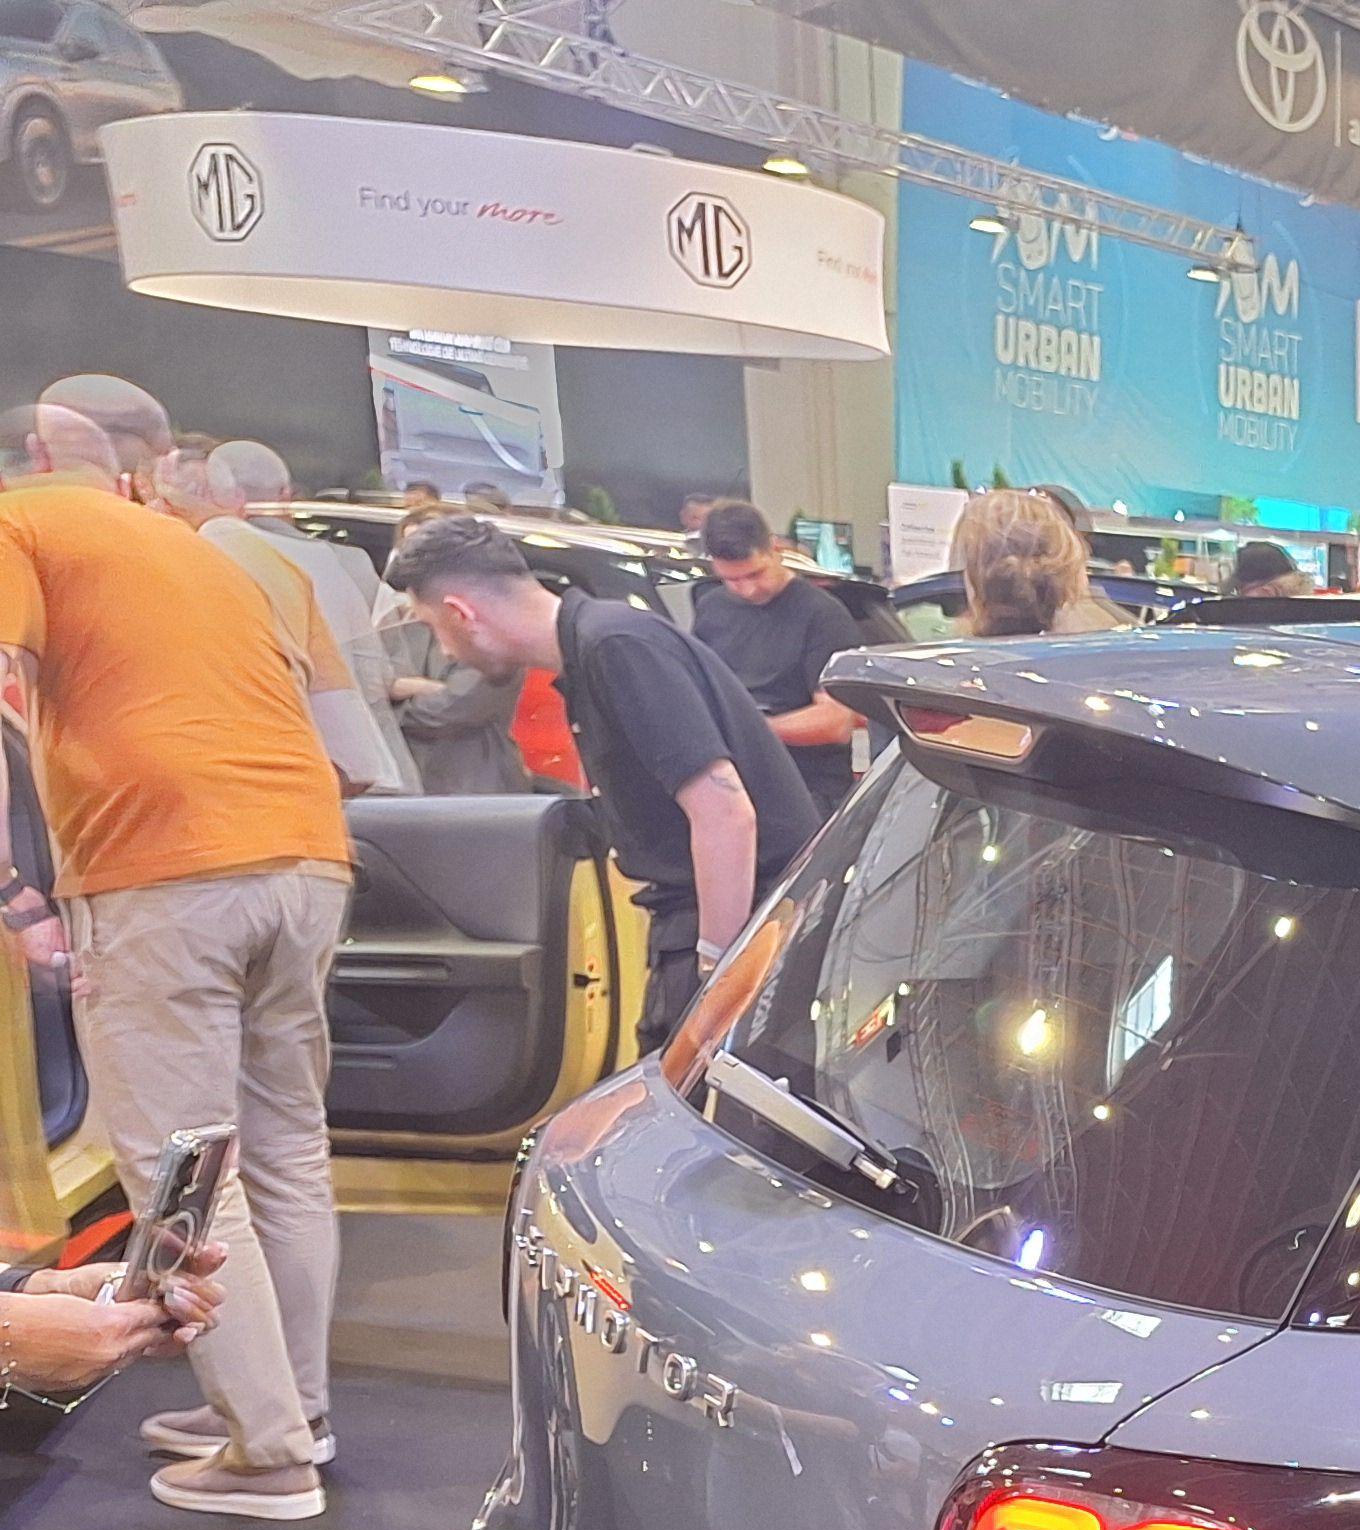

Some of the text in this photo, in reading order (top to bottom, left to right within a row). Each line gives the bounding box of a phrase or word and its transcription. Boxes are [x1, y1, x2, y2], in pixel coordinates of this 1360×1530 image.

[195, 150, 258, 235] MG
[358, 186, 565, 226] Find your more
[675, 199, 746, 281] MG
[996, 261, 1105, 331] SMART
[995, 312, 1101, 382] URBAN
[1220, 317, 1303, 375] SMART
[995, 366, 1100, 416] MOBILITY
[1218, 362, 1300, 421] URBAN
[1217, 410, 1299, 451] MOBILITY
